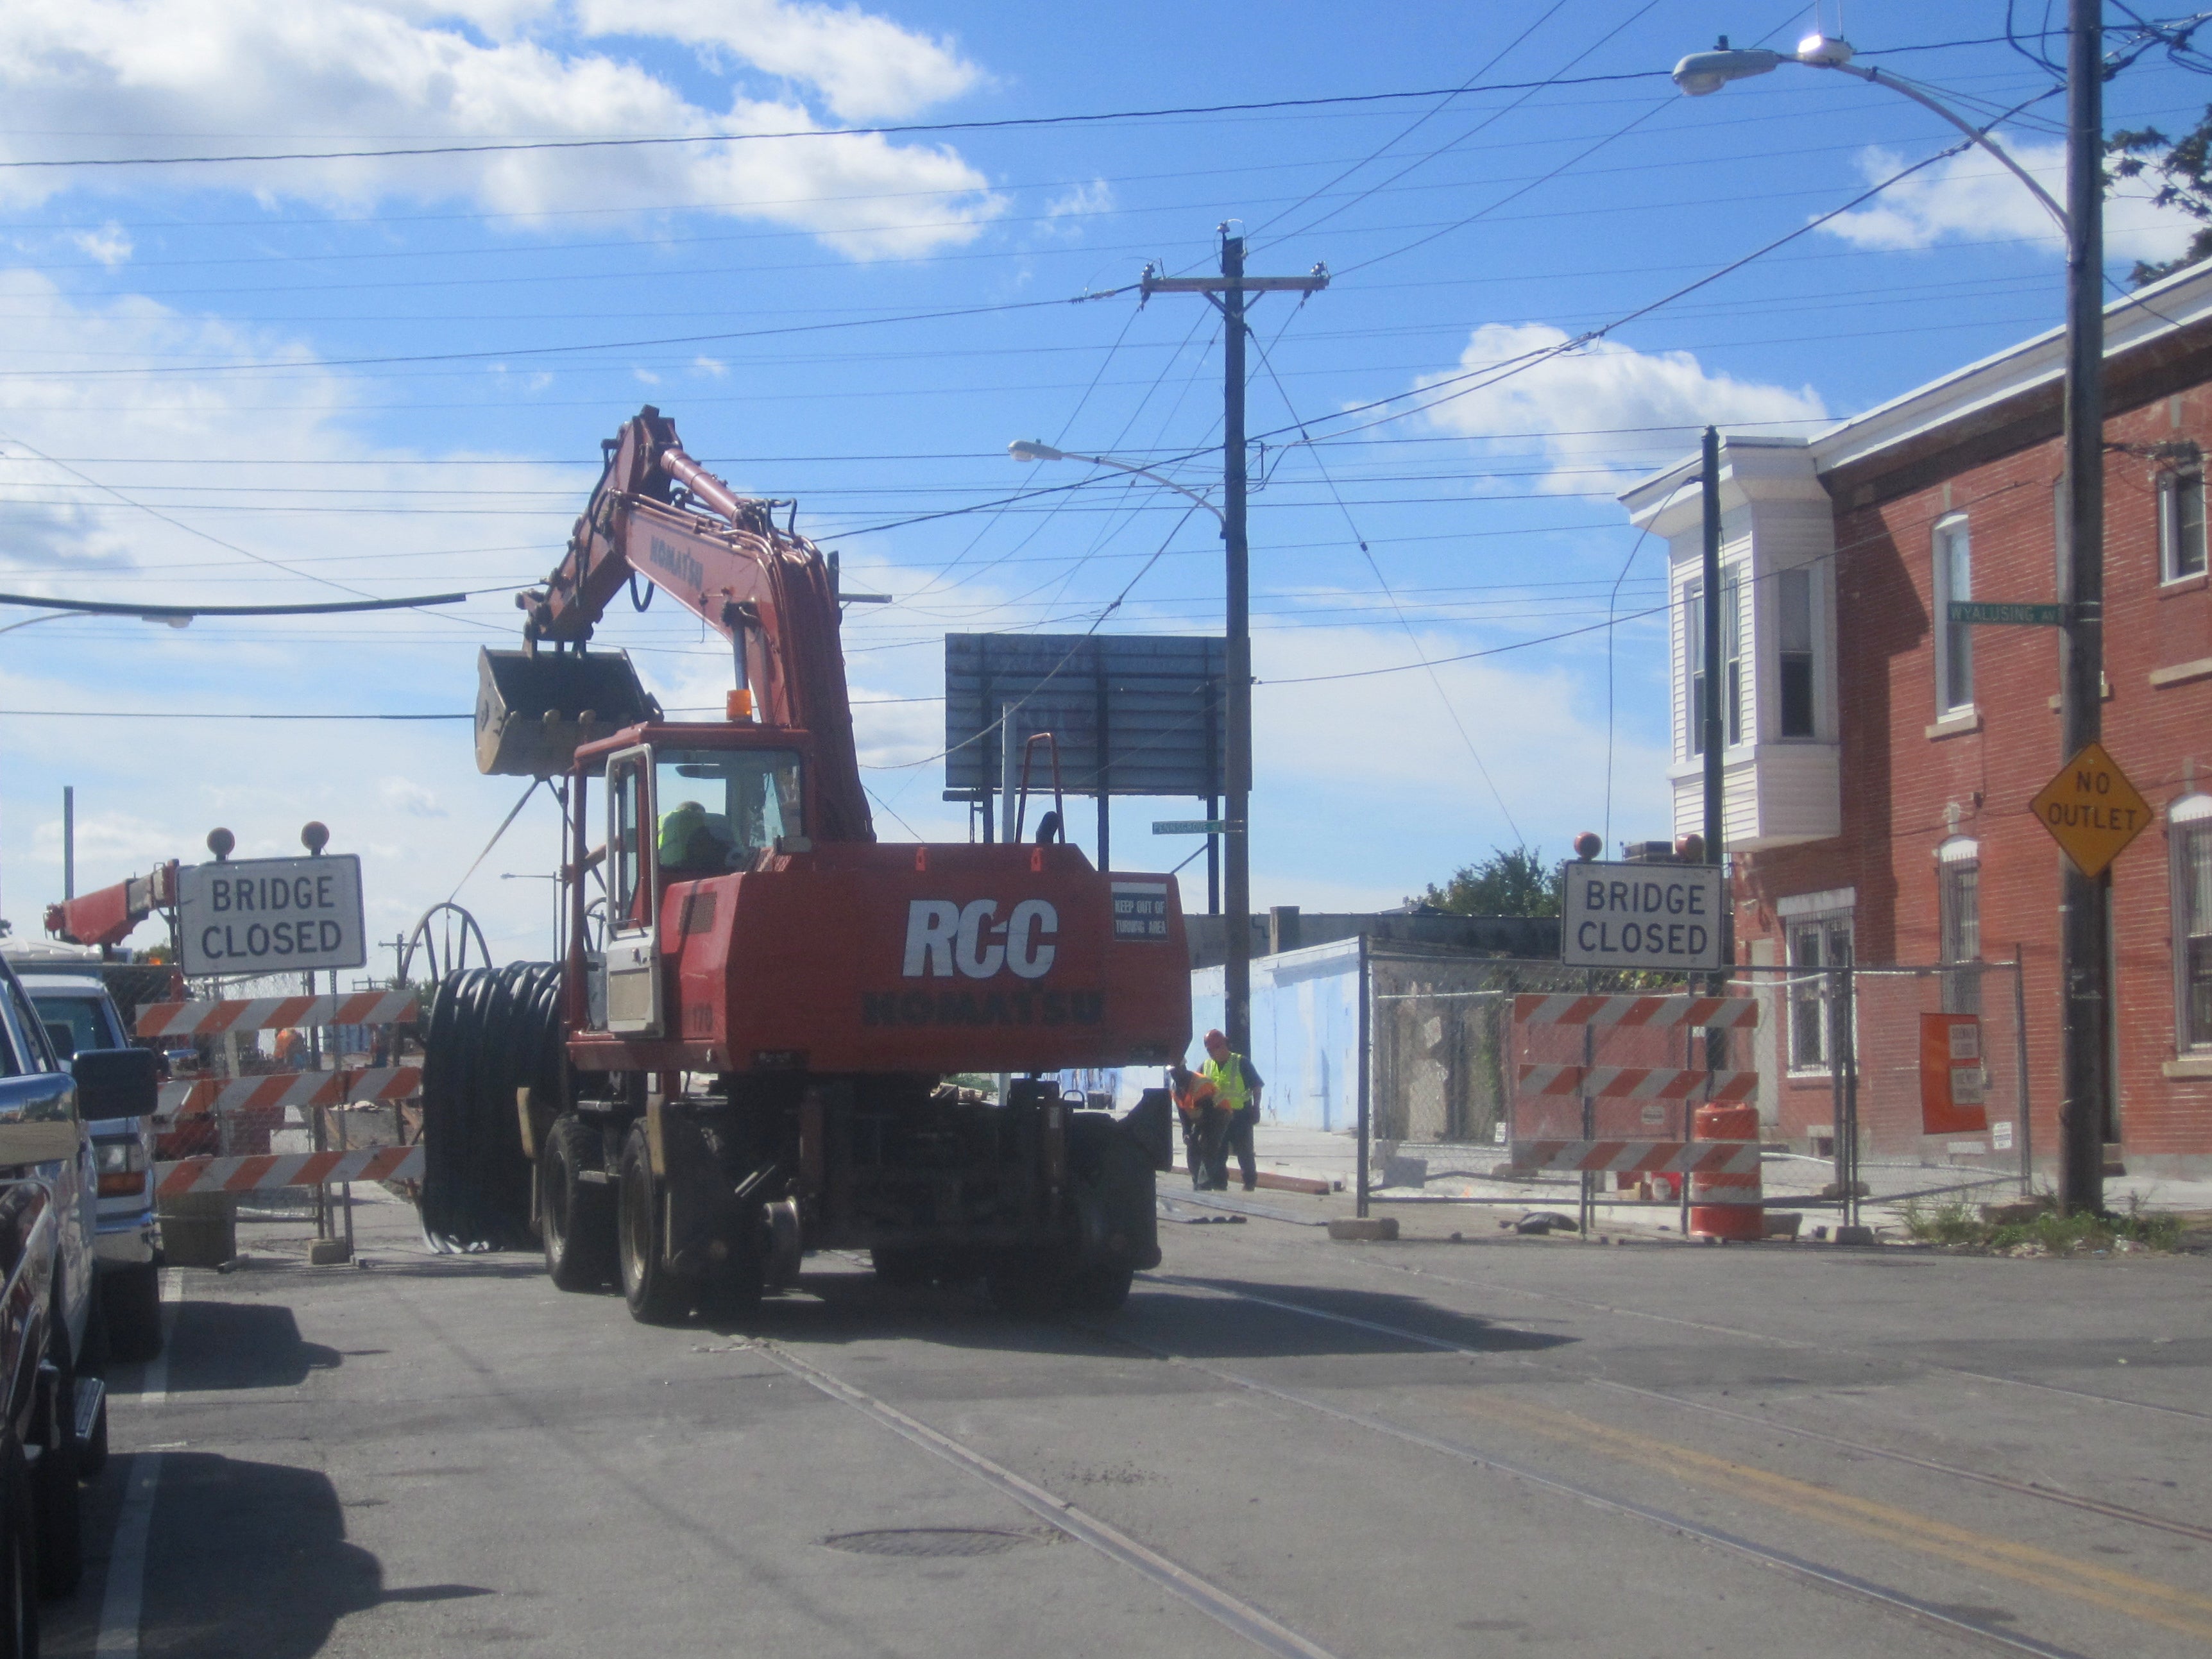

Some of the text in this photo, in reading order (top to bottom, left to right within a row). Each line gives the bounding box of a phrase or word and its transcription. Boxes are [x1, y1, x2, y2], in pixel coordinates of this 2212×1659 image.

[650, 535, 704, 591] KOMATSU
[1951, 606, 2034, 622] WYALUSING
[2077, 771, 2110, 794] NO
[1153, 822, 1207, 833] PENNSGROVE
[2048, 803, 2136, 831] OUTLET
[212, 876, 336, 912] BRIDGE
[1115, 899, 1165, 915] KEEP OUT OF
[1586, 880, 1706, 915] BRIDGE
[201, 920, 341, 959] CLOSED
[902, 899, 1059, 978] RCC
[1115, 919, 1166, 934] TURNING AREA
[1578, 921, 1707, 955] CLOSED
[862, 983, 1105, 1025] KOMATSU
